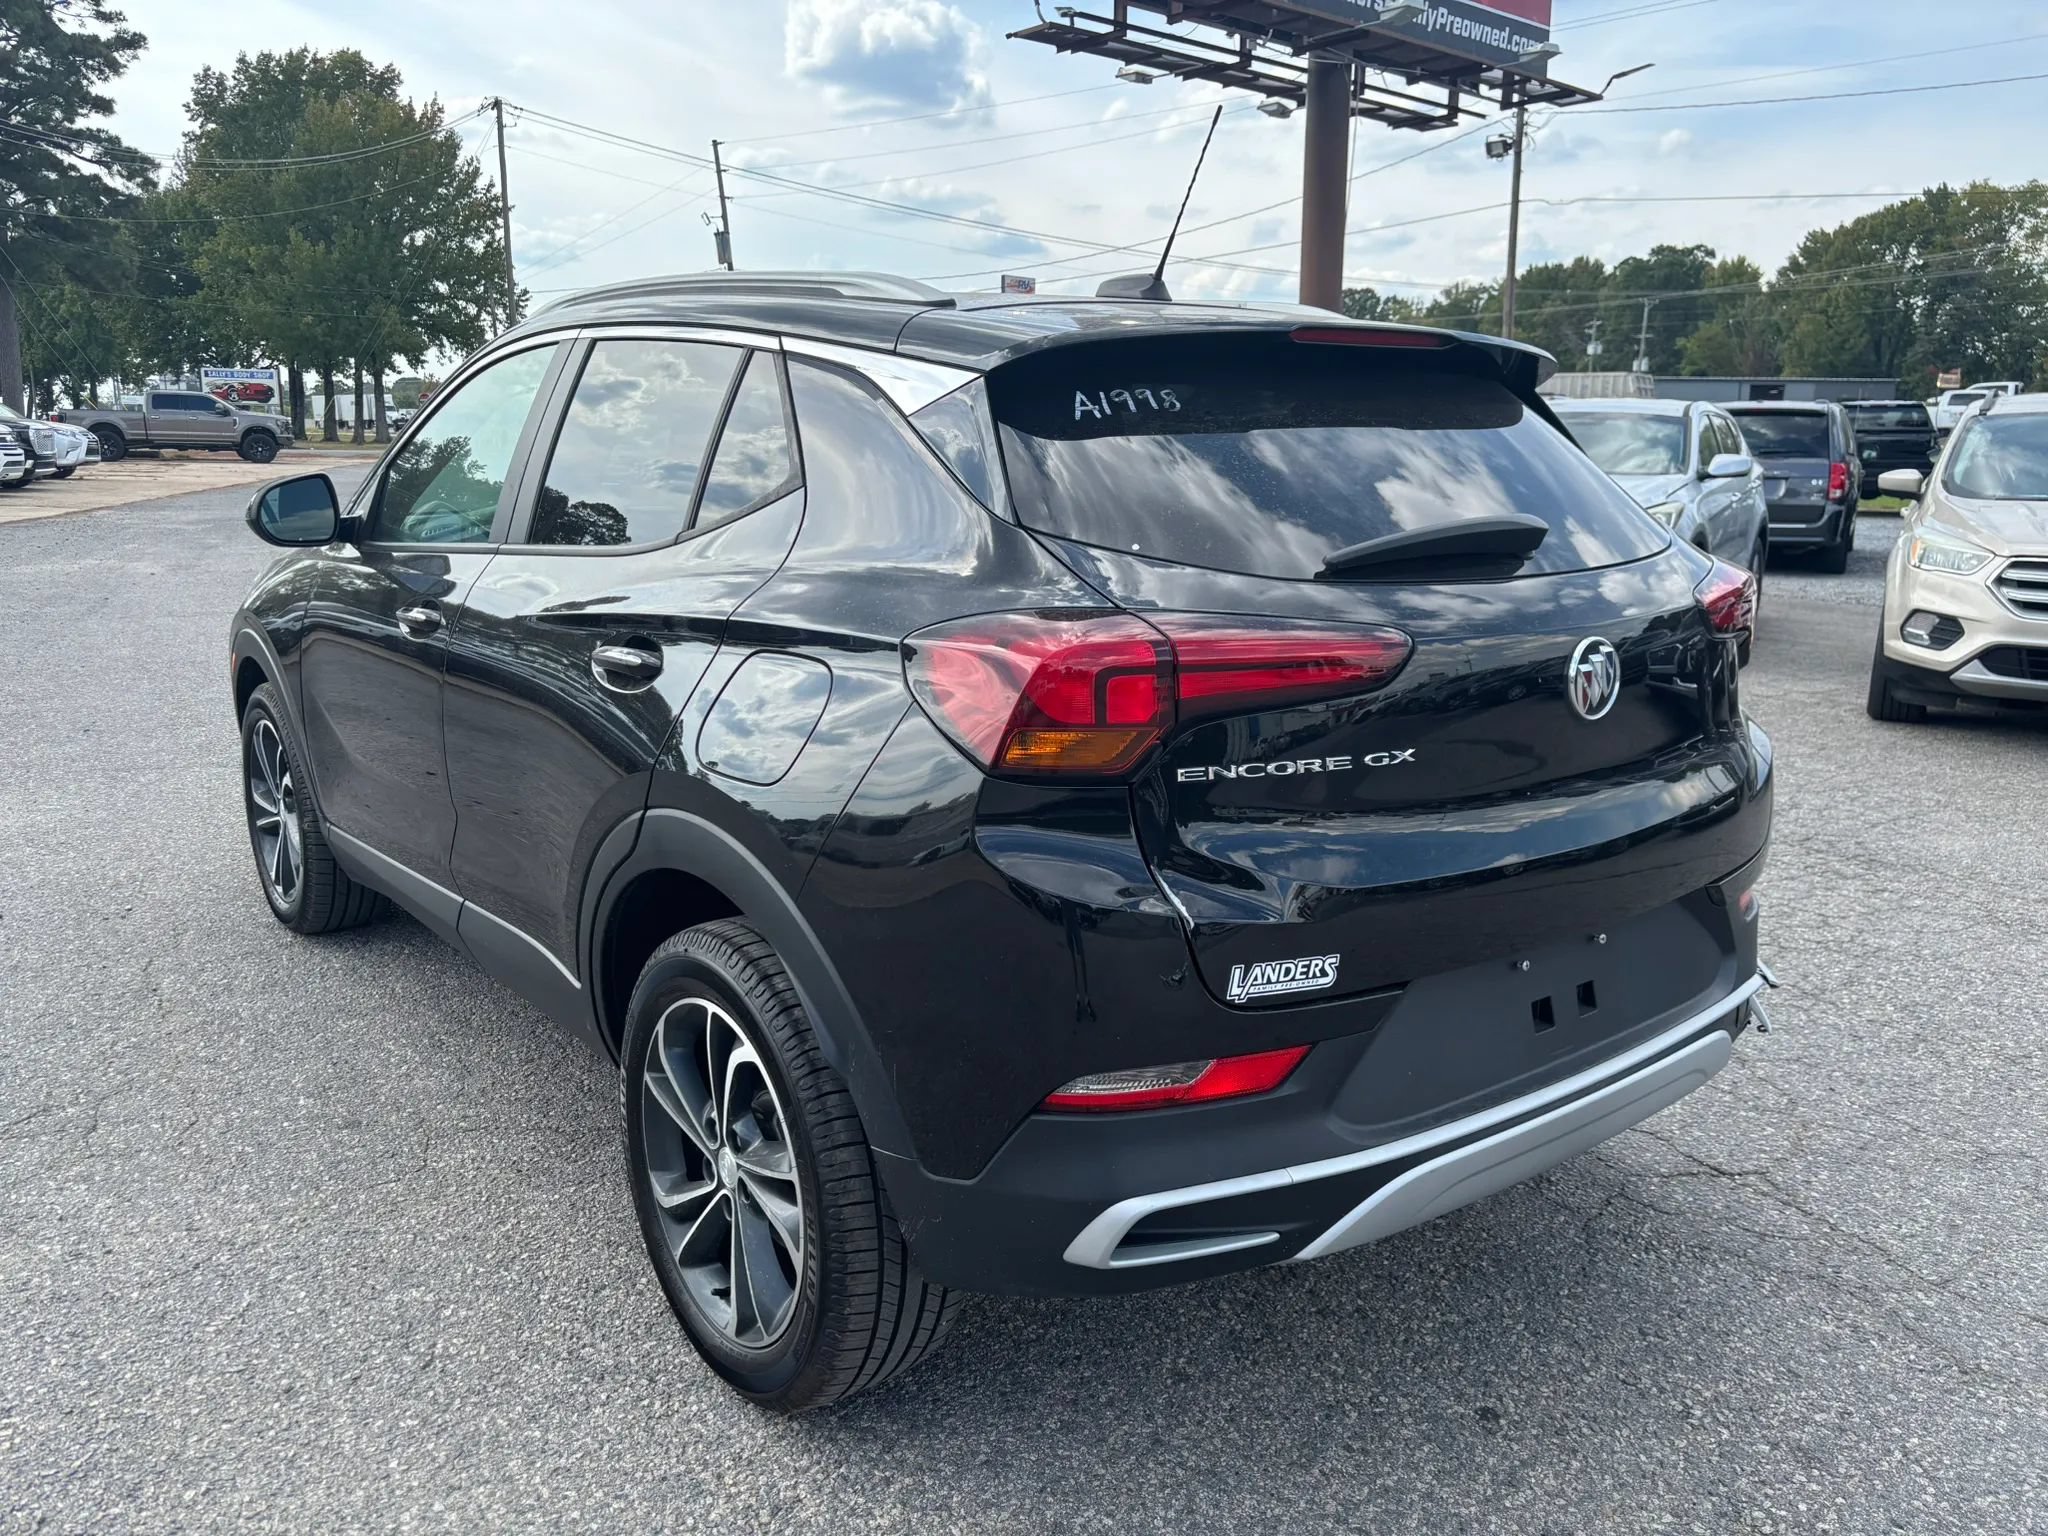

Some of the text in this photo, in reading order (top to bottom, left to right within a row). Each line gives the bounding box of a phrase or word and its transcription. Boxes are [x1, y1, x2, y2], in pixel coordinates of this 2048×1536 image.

[1074, 389, 1181, 420] A1998
[1177, 748, 1416, 782] ENCORE GX
[1228, 955, 1339, 1001] LANDERS
